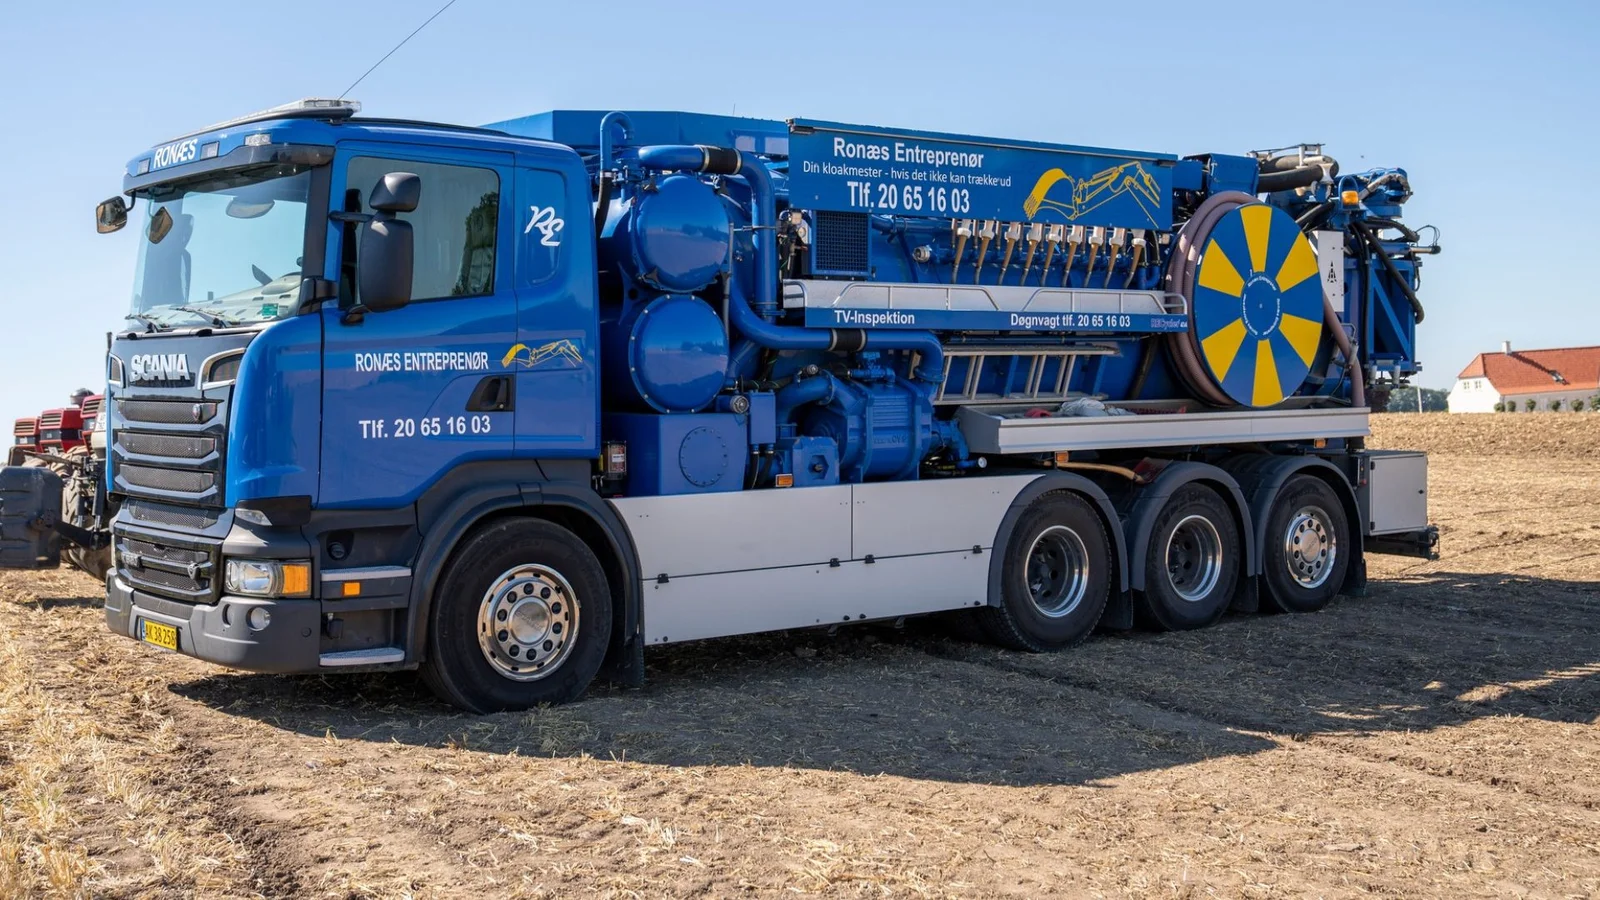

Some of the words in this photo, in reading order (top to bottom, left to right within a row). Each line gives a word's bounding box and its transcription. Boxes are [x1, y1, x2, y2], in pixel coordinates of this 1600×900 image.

[153, 139, 198, 169] RONÆS
[833, 137, 890, 161] Ronæs
[895, 142, 984, 168] Entreprenør
[803, 161, 820, 174] Din
[822, 162, 883, 178] kloakmester
[891, 167, 910, 180] hvis
[911, 169, 927, 181] det
[929, 170, 948, 183] ikke
[949, 172, 966, 184] kan
[967, 173, 999, 186] trække
[1000, 176, 1012, 187] ud
[847, 181, 875, 208] Tlf.
[878, 183, 898, 209] 20
[903, 185, 923, 211] 65
[927, 187, 947, 212] 16
[951, 188, 970, 214] 03
[834, 310, 916, 326] TV-Inspektion
[1010, 313, 1061, 329] Døgnvagt
[1062, 314, 1076, 327] tlf.
[1077, 315, 1090, 327] 20
[1091, 315, 1104, 327] 65
[1106, 315, 1118, 328] 16
[1119, 315, 1131, 328] 03
[130, 353, 191, 382] SCANIA
[355, 353, 402, 373] RONÆS
[404, 351, 489, 371] ENTREPRENØR
[359, 419, 389, 439] Tlf.
[394, 418, 416, 438] 20
[420, 417, 441, 436] 65
[446, 416, 467, 435] 16
[471, 415, 491, 434] 03
